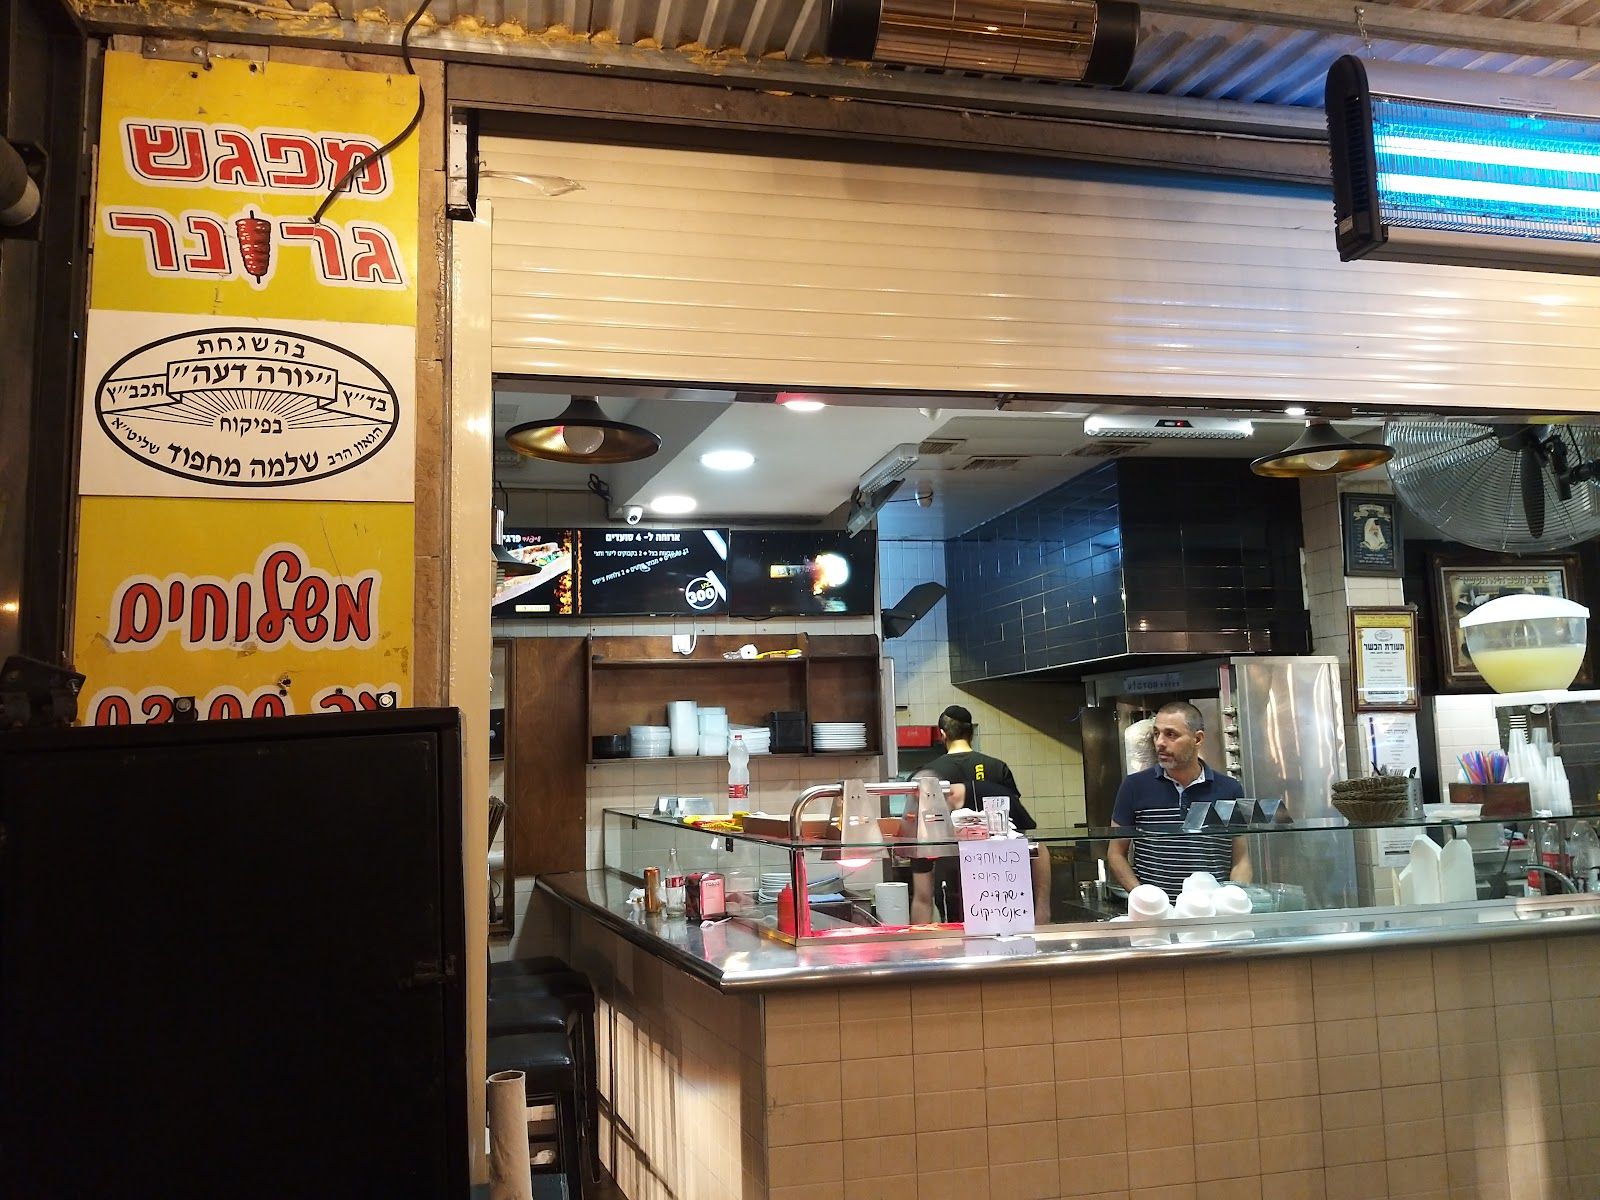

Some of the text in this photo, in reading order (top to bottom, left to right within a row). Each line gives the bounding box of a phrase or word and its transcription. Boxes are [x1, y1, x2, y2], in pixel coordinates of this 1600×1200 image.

[126, 123, 388, 195] מפגש
[197, 335, 305, 359] בהשגחת
[220, 416, 283, 438] בפיקוח
[353, 426, 383, 454] הגאון
[167, 442, 241, 478] מחפוד
[249, 450, 319, 478] שלמה
[328, 448, 352, 467] הרב
[635, 533, 642, 542] 4
[655, 533, 681, 542] ארוחה
[113, 551, 374, 644] משלוחים
[687, 587, 715, 604] 300
[964, 850, 1021, 866] במיוחדים
